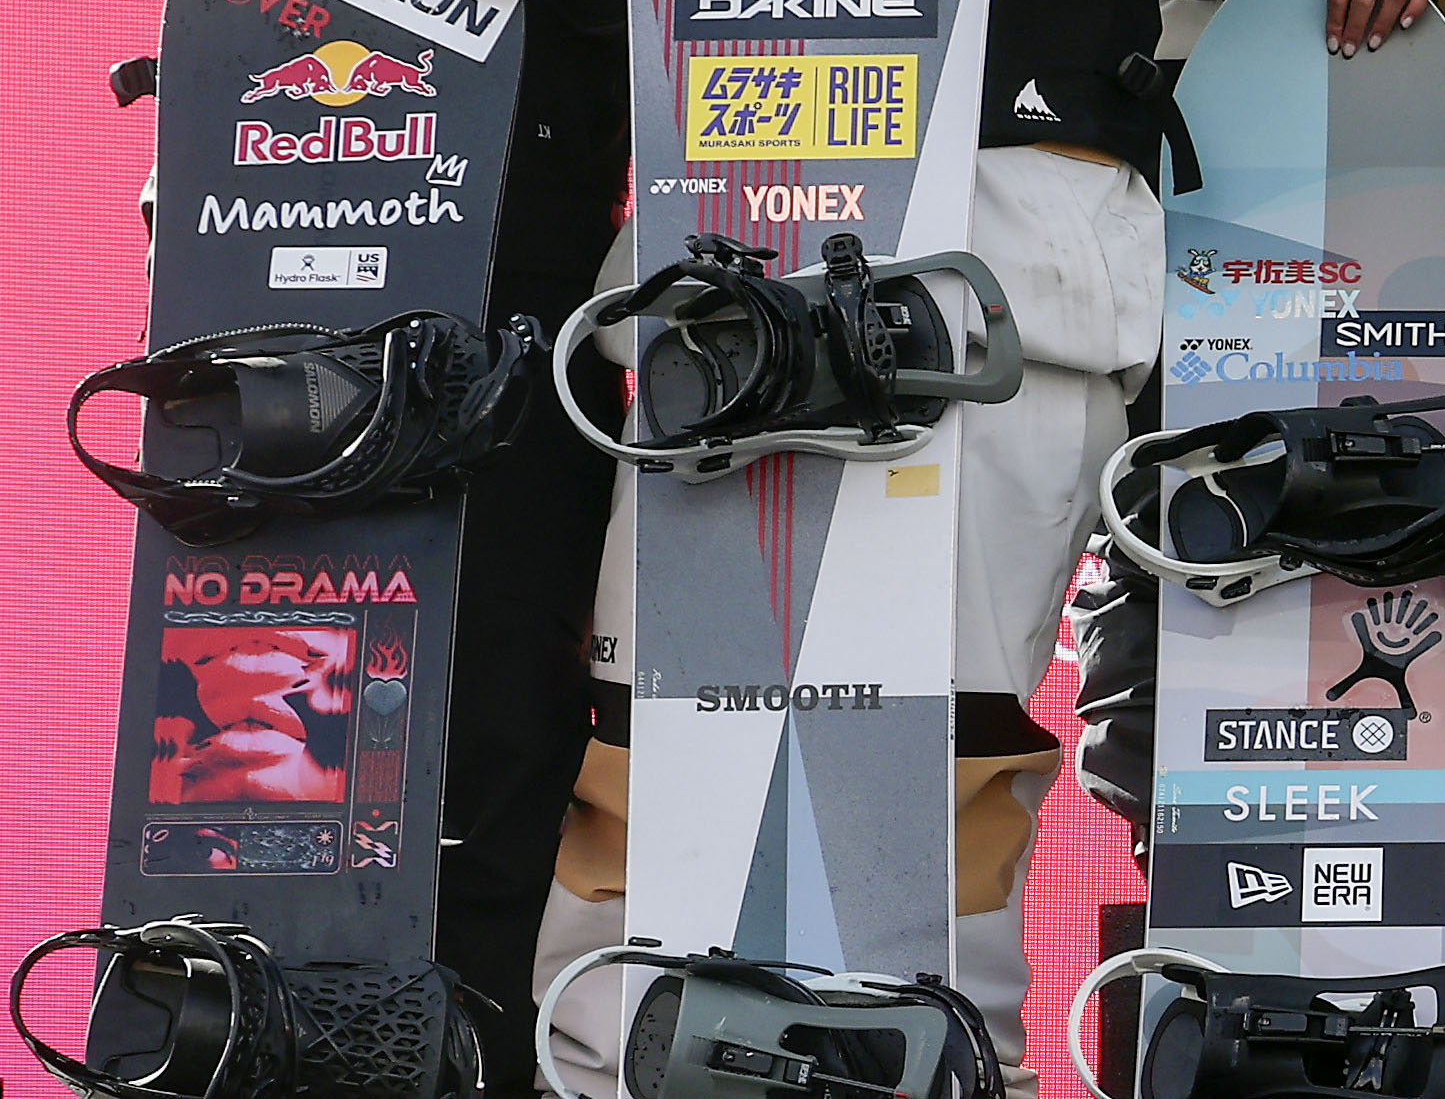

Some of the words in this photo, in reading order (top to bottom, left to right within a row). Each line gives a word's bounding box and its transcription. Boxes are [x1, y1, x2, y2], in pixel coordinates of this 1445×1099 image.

[701, 66, 803, 100] ムラサキ
[829, 66, 905, 105] RIDE
[699, 101, 803, 136] スポーツ
[827, 107, 904, 146] LIFE
[235, 117, 336, 165] Red
[340, 112, 437, 163] Bull
[699, 139, 755, 148] MURASAKI
[758, 139, 801, 148] SPORTS
[679, 178, 727, 194] YONEX
[198, 187, 465, 235] Mammoth
[743, 183, 866, 222] YONEX
[358, 253, 380, 263] US
[274, 273, 307, 284] Hydro
[308, 273, 338, 283] Flask
[1251, 288, 1362, 319] YONEX
[1207, 338, 1251, 350] YONEX
[1216, 351, 1404, 383] Columbia
[304, 362, 321, 433] SALOMON
[164, 572, 229, 606] NO
[239, 570, 418, 605] DRAMA
[696, 683, 884, 713] SMOOTH
[1217, 719, 1341, 751] STANCE
[1223, 783, 1379, 822] SLEEK
[1314, 863, 1373, 884] NEW
[1314, 886, 1372, 906] ERA
